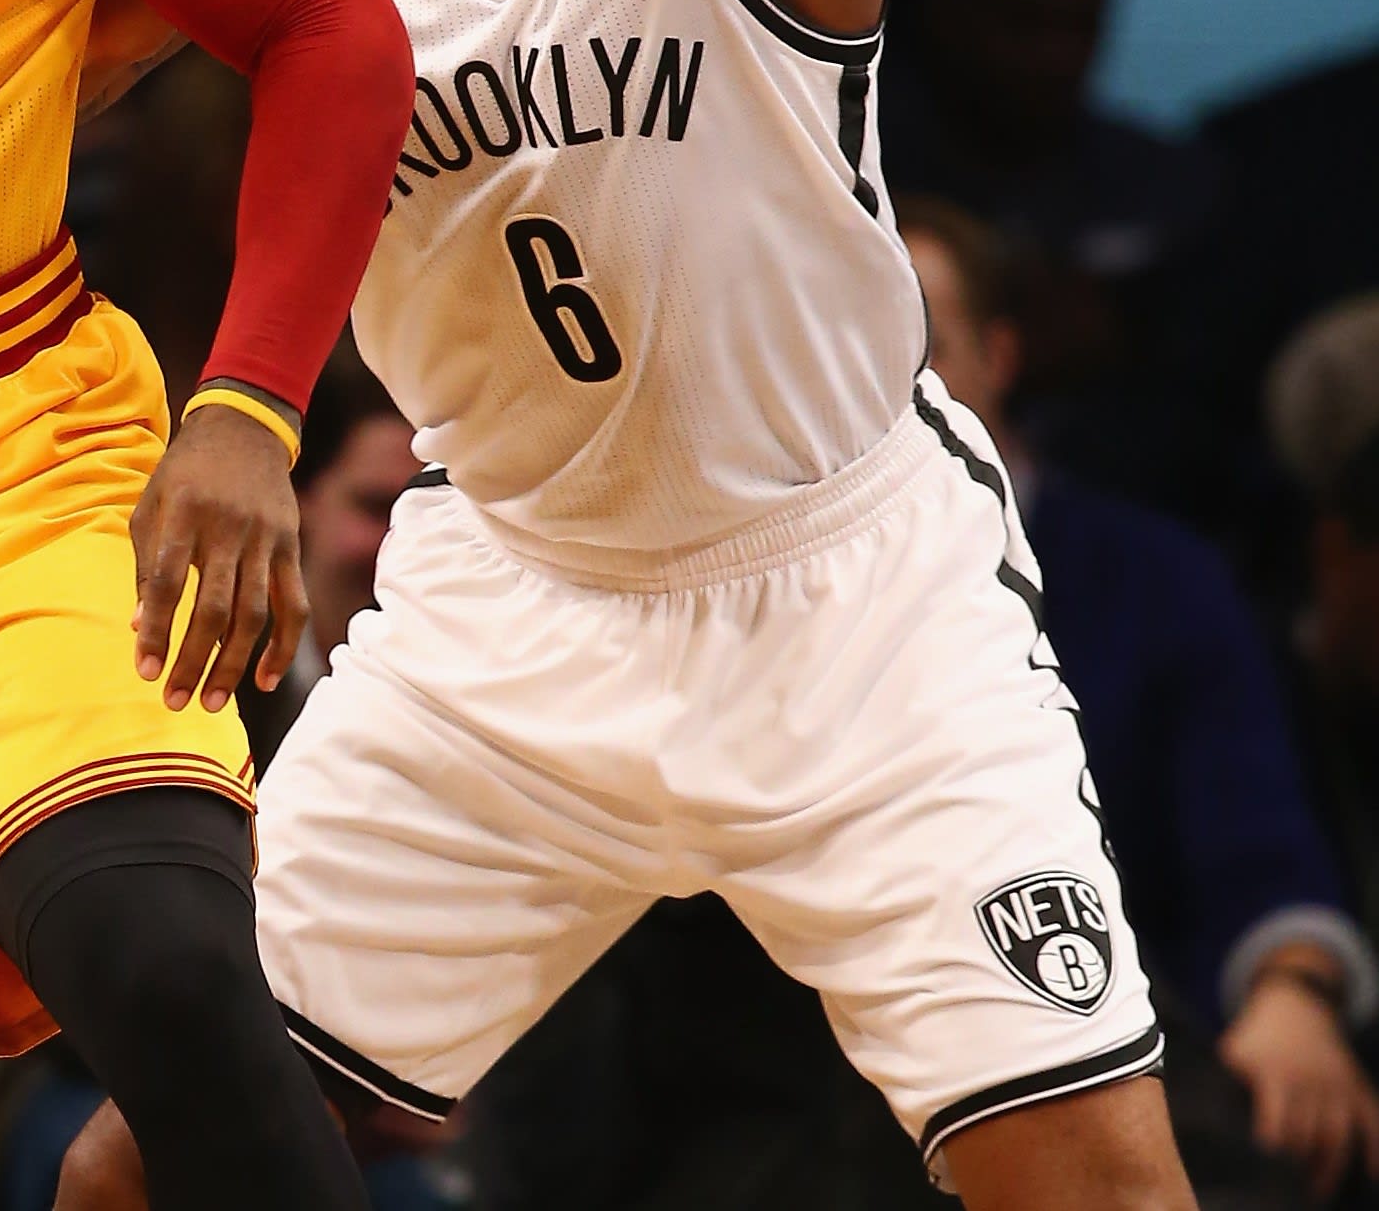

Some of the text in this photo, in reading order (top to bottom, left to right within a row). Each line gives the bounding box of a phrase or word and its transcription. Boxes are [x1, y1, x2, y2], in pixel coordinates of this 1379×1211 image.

[382, 38, 704, 219] OOKLYN
[506, 219, 621, 382] 6
[988, 881, 1108, 952] NETS
[1060, 944, 1088, 991] B
